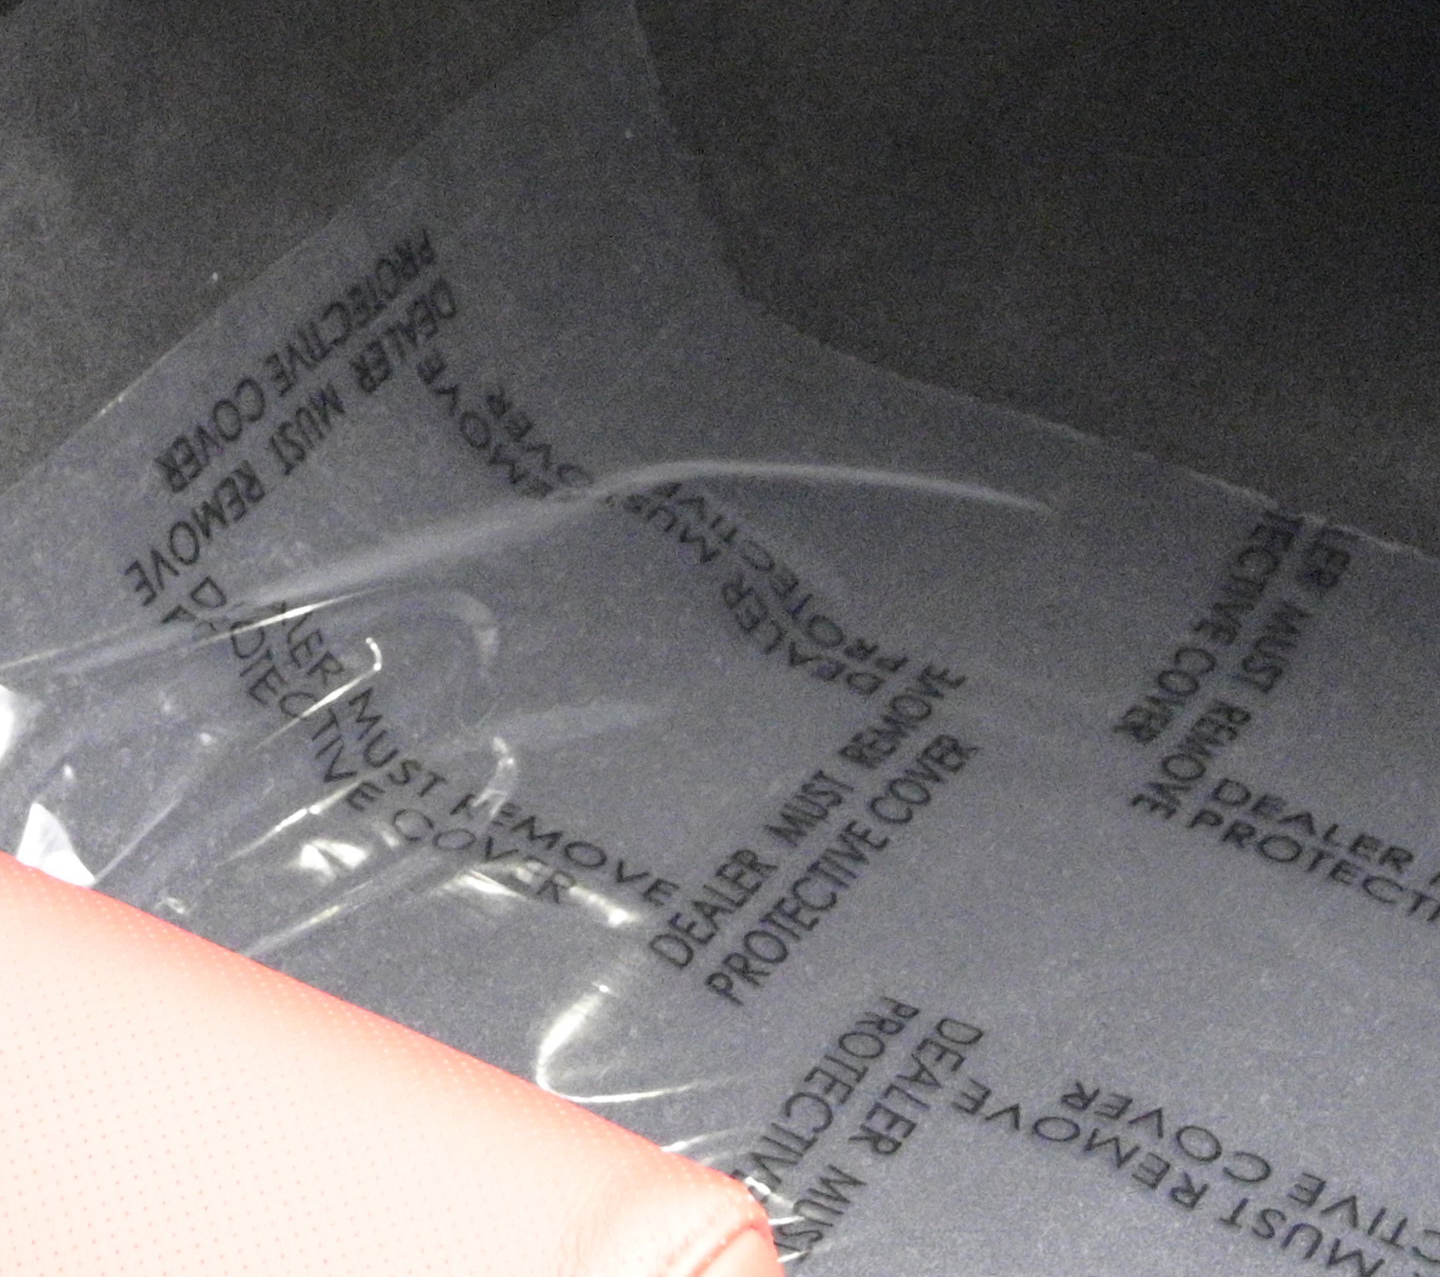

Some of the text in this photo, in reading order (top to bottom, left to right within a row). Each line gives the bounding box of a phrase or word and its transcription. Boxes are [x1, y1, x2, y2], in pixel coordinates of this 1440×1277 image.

[155, 376, 267, 493] COVER
[268, 384, 346, 476] MUST
[124, 459, 266, 607] REMOVE
[347, 686, 447, 799] MUST
[647, 663, 966, 968] DEALER MUST REMOVE
[704, 733, 983, 1007] PROTECTIVE COVER
[1211, 776, 1414, 875] DEALER
[847, 1017, 984, 1156] DEALER
[951, 1077, 1210, 1211] REMOVE
[1059, 1081, 1273, 1184] COVER
